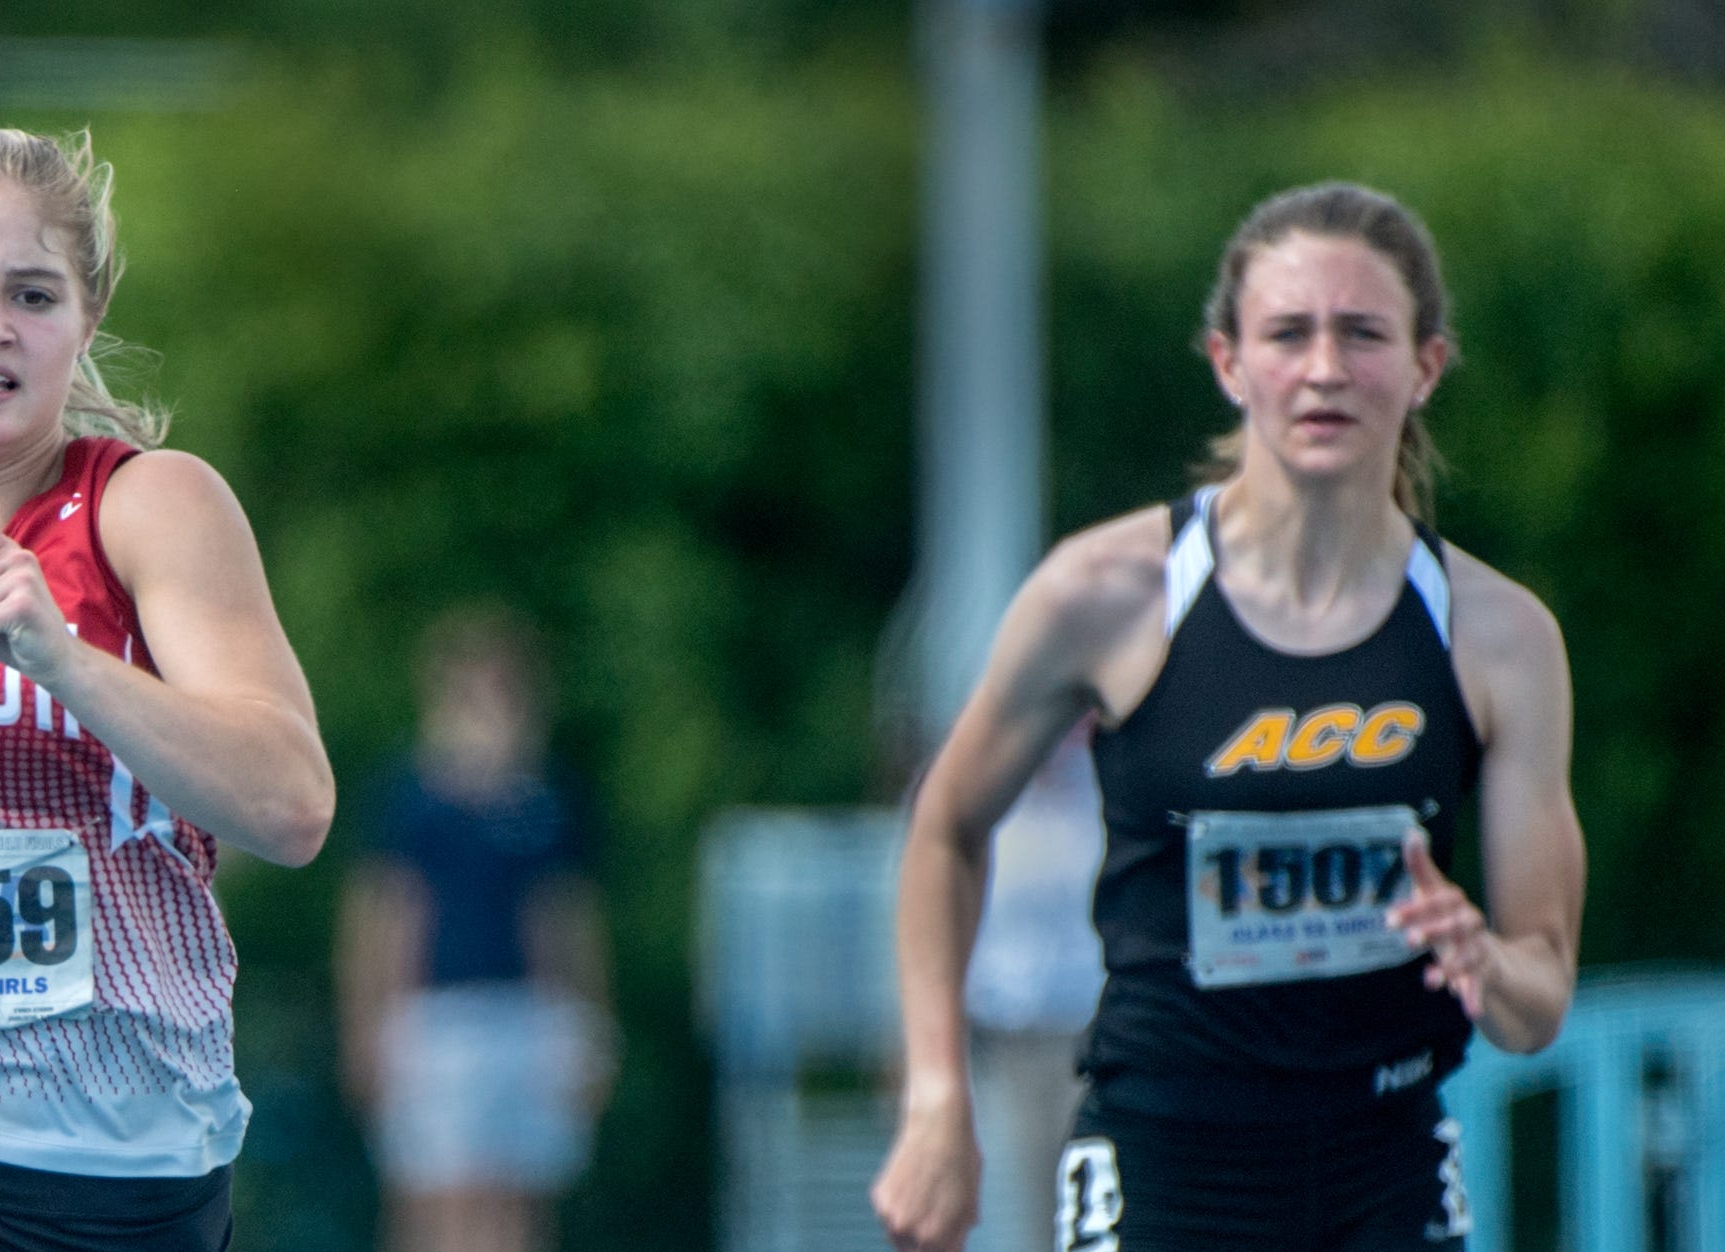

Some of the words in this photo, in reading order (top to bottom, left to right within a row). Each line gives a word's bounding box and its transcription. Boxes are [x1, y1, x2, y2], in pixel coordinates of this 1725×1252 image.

[1204, 700, 1426, 777] ACC
[1205, 843, 1405, 920] 1507
[1374, 1050, 1434, 1097] NIK
